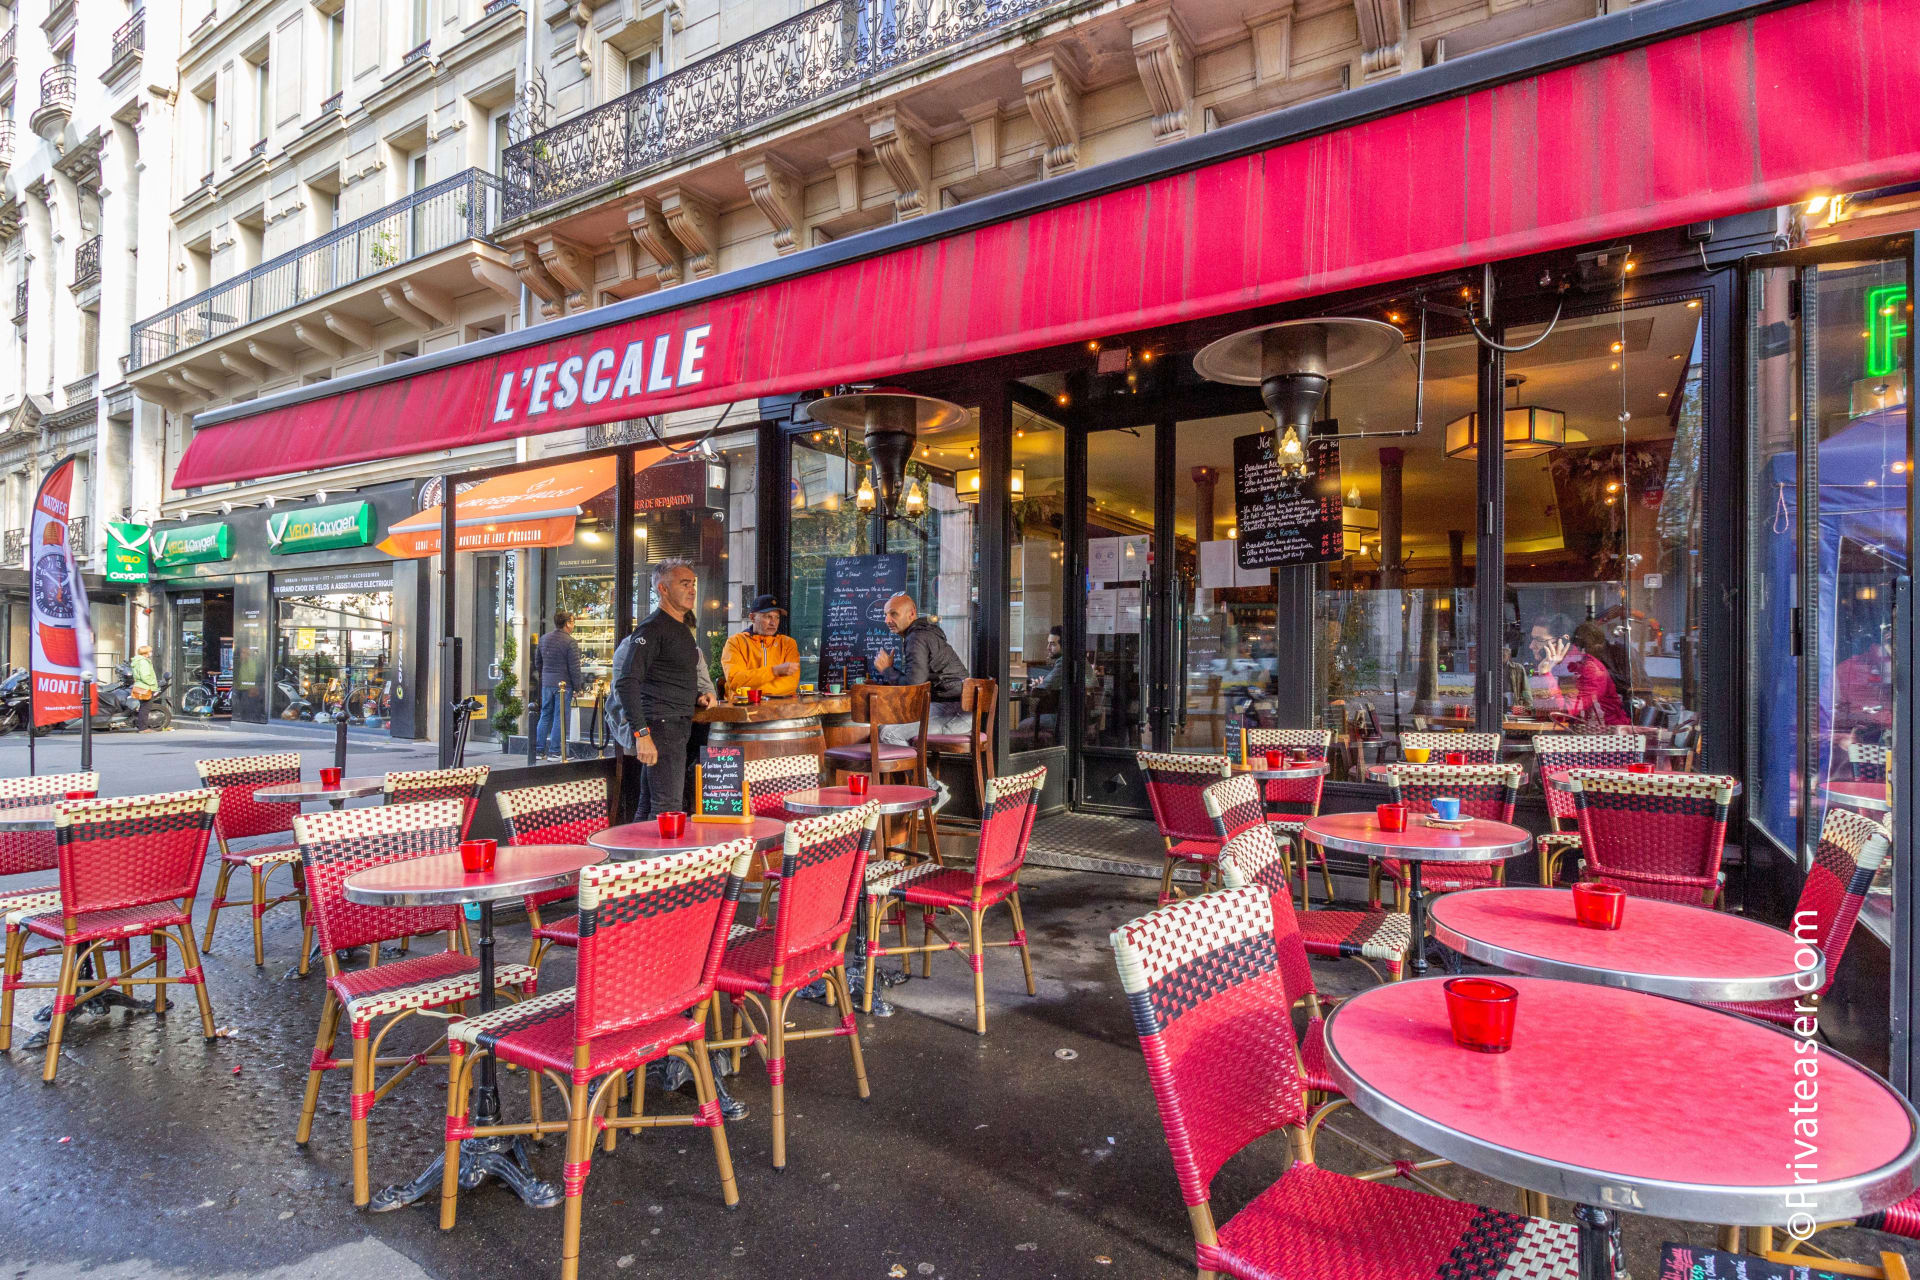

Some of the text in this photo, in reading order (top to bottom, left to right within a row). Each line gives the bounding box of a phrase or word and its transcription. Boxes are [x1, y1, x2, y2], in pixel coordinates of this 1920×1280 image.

[493, 323, 711, 424] L'ESCALE
[43, 493, 68, 517] WATCHES
[645, 499, 654, 509] DE
[655, 494, 694, 508] REPARATION
[116, 555, 141, 564] VELO
[110, 572, 147, 581] Oxygen
[280, 585, 295, 593] GRAND
[295, 584, 308, 592] CHOIX
[308, 584, 315, 592] DE
[335, 580, 364, 590] ASSISTANCE
[364, 579, 394, 588] ELECTRIQUE
